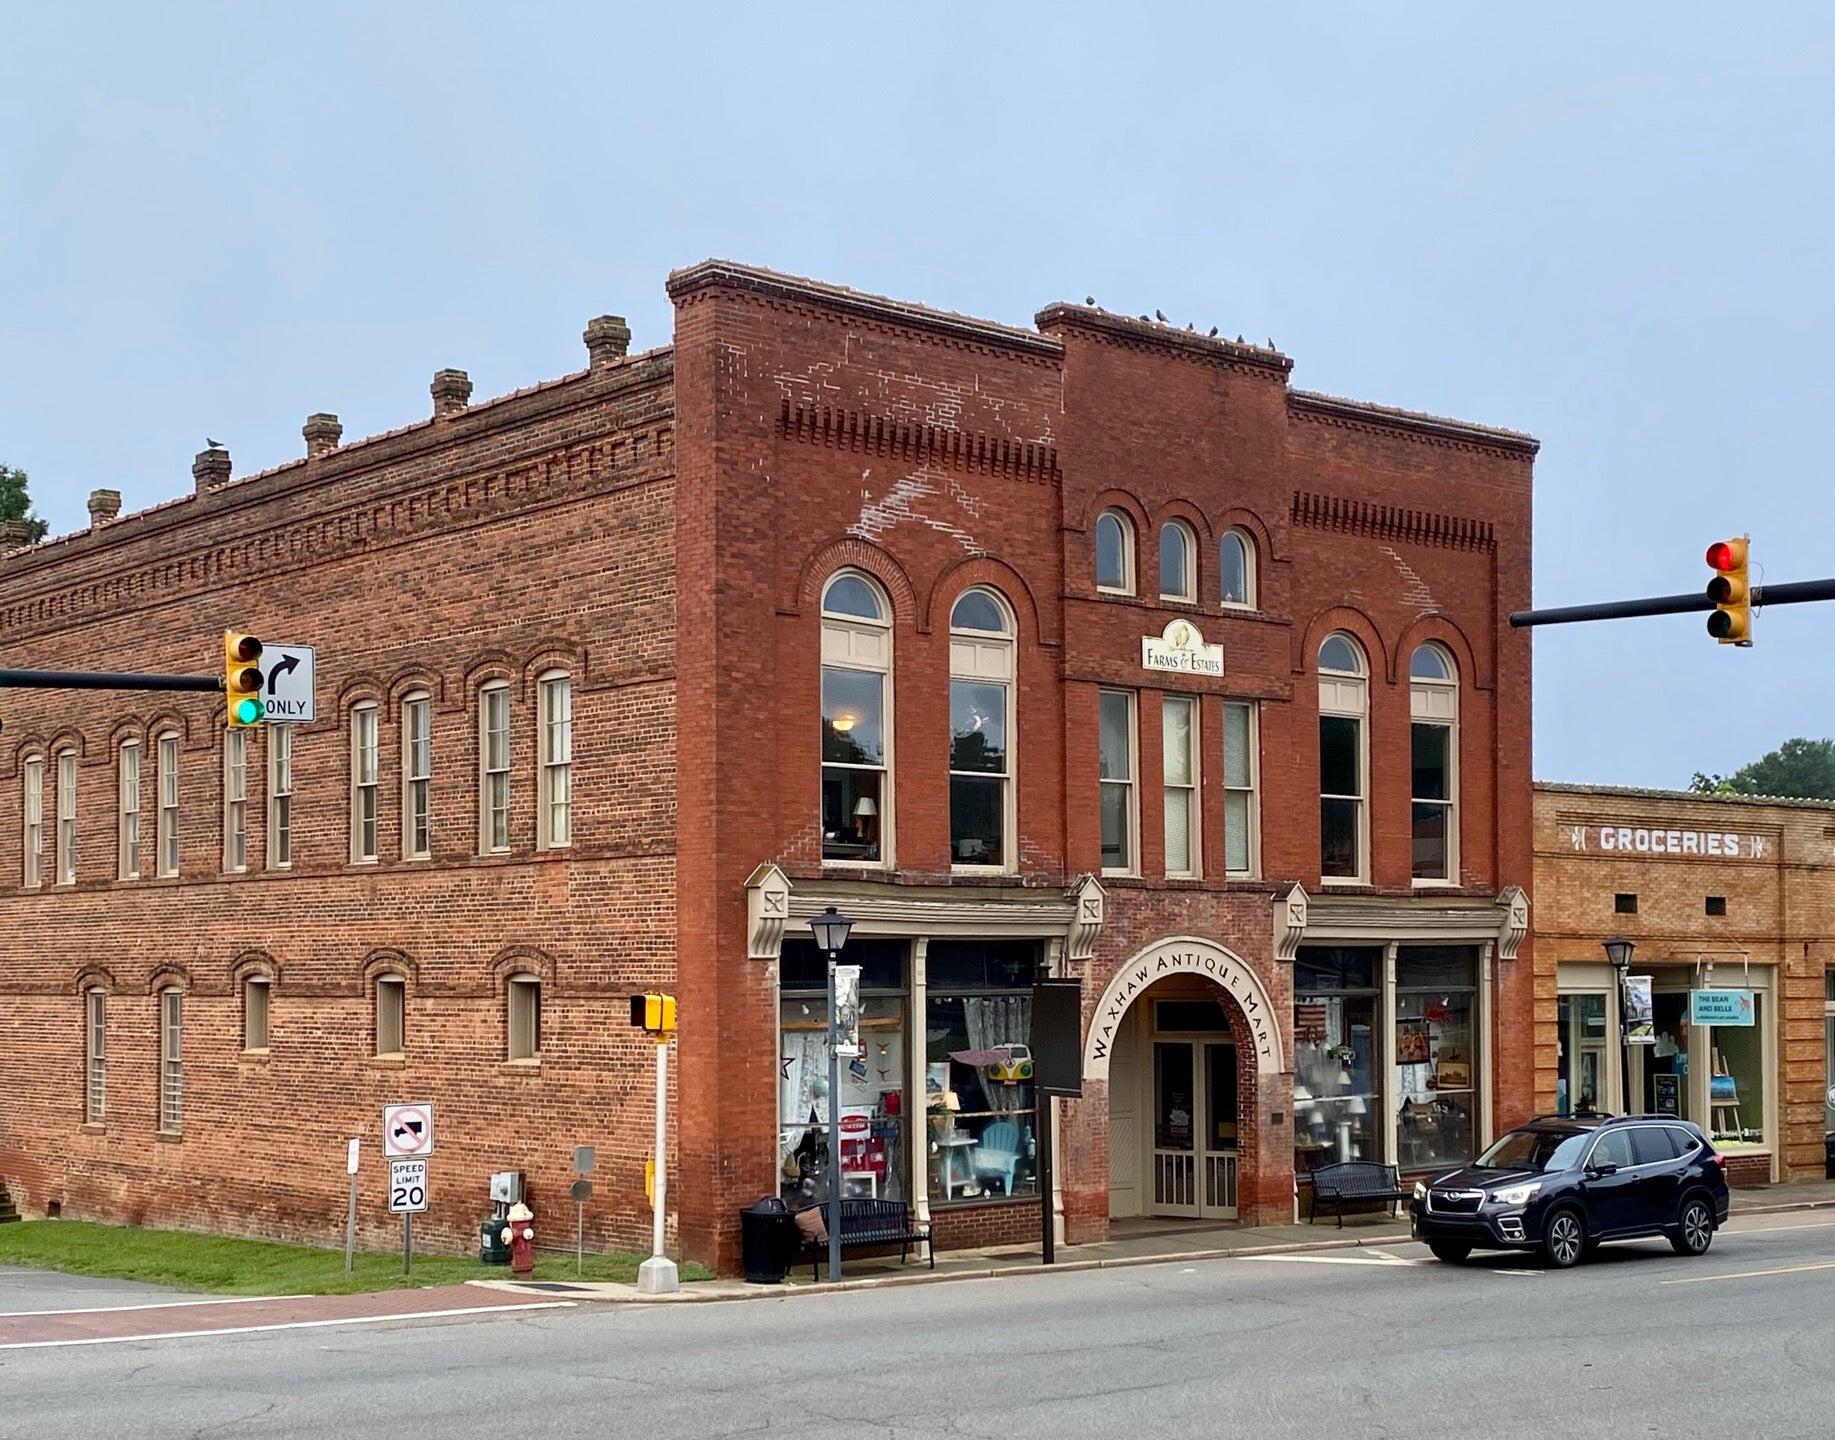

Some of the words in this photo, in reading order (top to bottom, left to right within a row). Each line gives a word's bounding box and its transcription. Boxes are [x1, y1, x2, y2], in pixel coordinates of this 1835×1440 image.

[1147, 648, 1178, 669] FARMS
[1191, 653, 1220, 673] ESTATES
[265, 699, 306, 715] ONLY
[1599, 826, 1740, 857] GROCERIES
[1093, 966, 1149, 1060] WAXHAW
[1156, 953, 1240, 988] ANTIQUE
[1243, 991, 1272, 1058] MART
[1698, 995, 1710, 1003] THE
[1711, 995, 1729, 1003] BEAN
[393, 1164, 424, 1174] SPEED
[396, 1175, 420, 1185] LIMIT
[393, 1186, 424, 1207] 20
